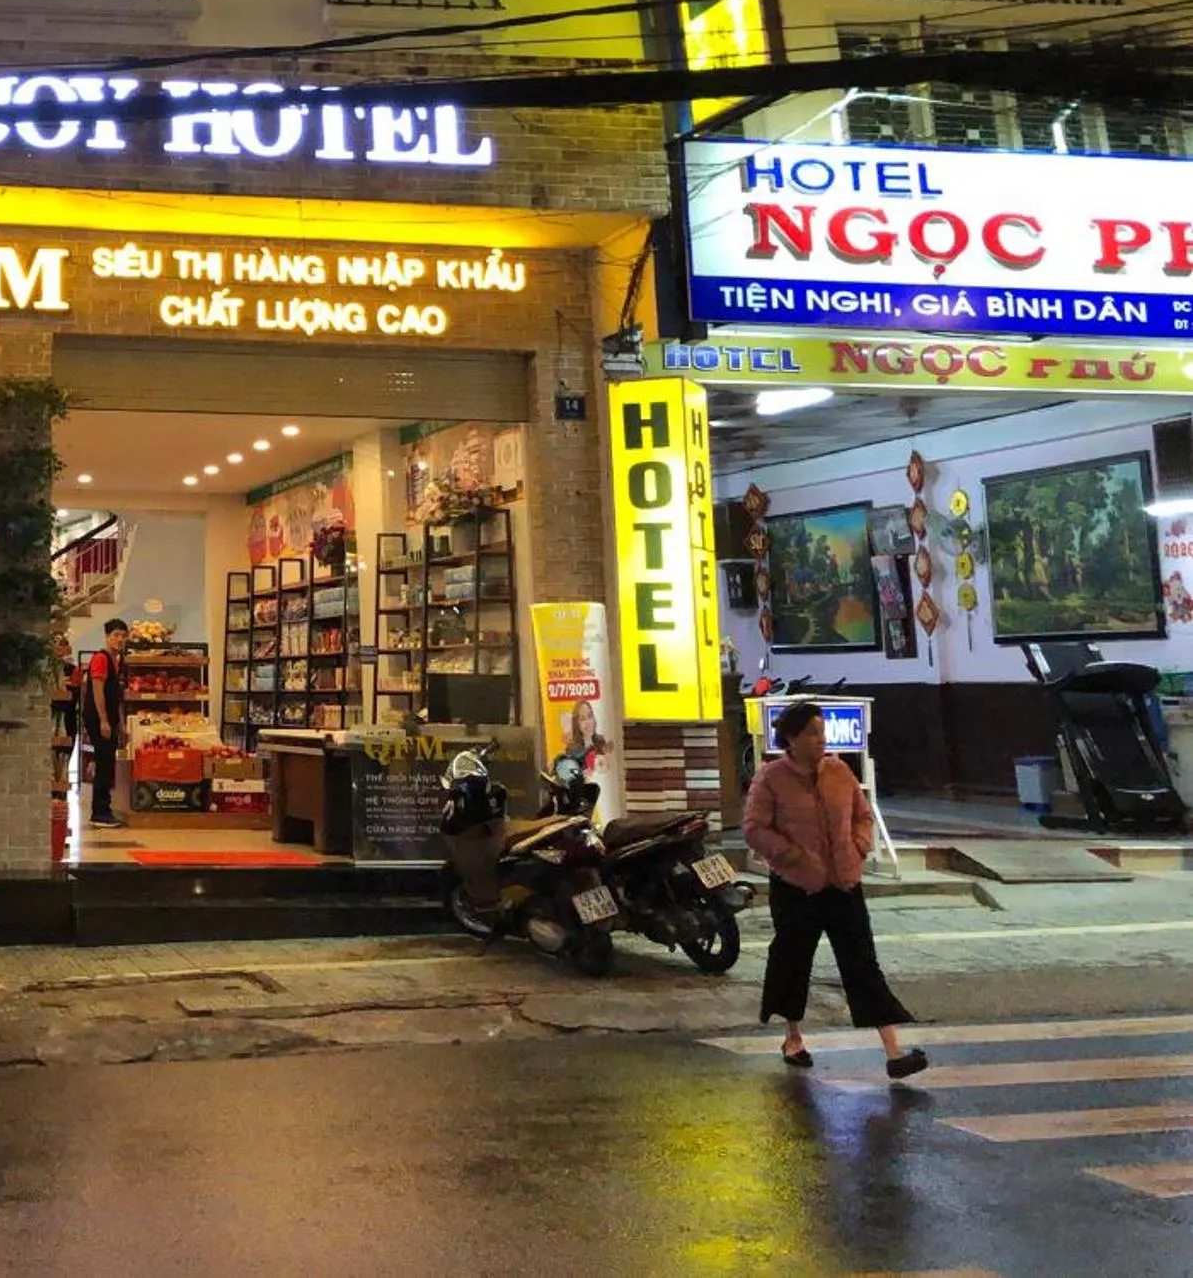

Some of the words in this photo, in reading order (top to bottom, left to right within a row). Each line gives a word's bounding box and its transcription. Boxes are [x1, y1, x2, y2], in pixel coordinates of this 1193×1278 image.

[162, 80, 494, 166] HOTEL
[742, 155, 944, 196] HOTEL
[746, 202, 1047, 279] NGỌC
[92, 246, 163, 279] SIÊU
[172, 250, 222, 285] THỊ
[234, 247, 325, 286] HÀNG
[338, 250, 425, 292] NHẬP
[437, 247, 526, 293] KHẨU
[159, 288, 245, 328] CHẤT
[257, 299, 367, 336] LƯỢNG
[377, 304, 447, 337] CAO
[719, 283, 795, 312] TIỆN
[806, 290, 901, 318] NGHI,
[912, 287, 975, 318] GIÁ
[987, 289, 1063, 321] BÌNH
[1074, 293, 1148, 323] DÂN
[665, 344, 801, 372] HOTEL
[829, 341, 1008, 384] NGỌC
[622, 401, 678, 693] HOTEL
[691, 407, 713, 648] HOTEL
[364, 735, 447, 766] QFM
